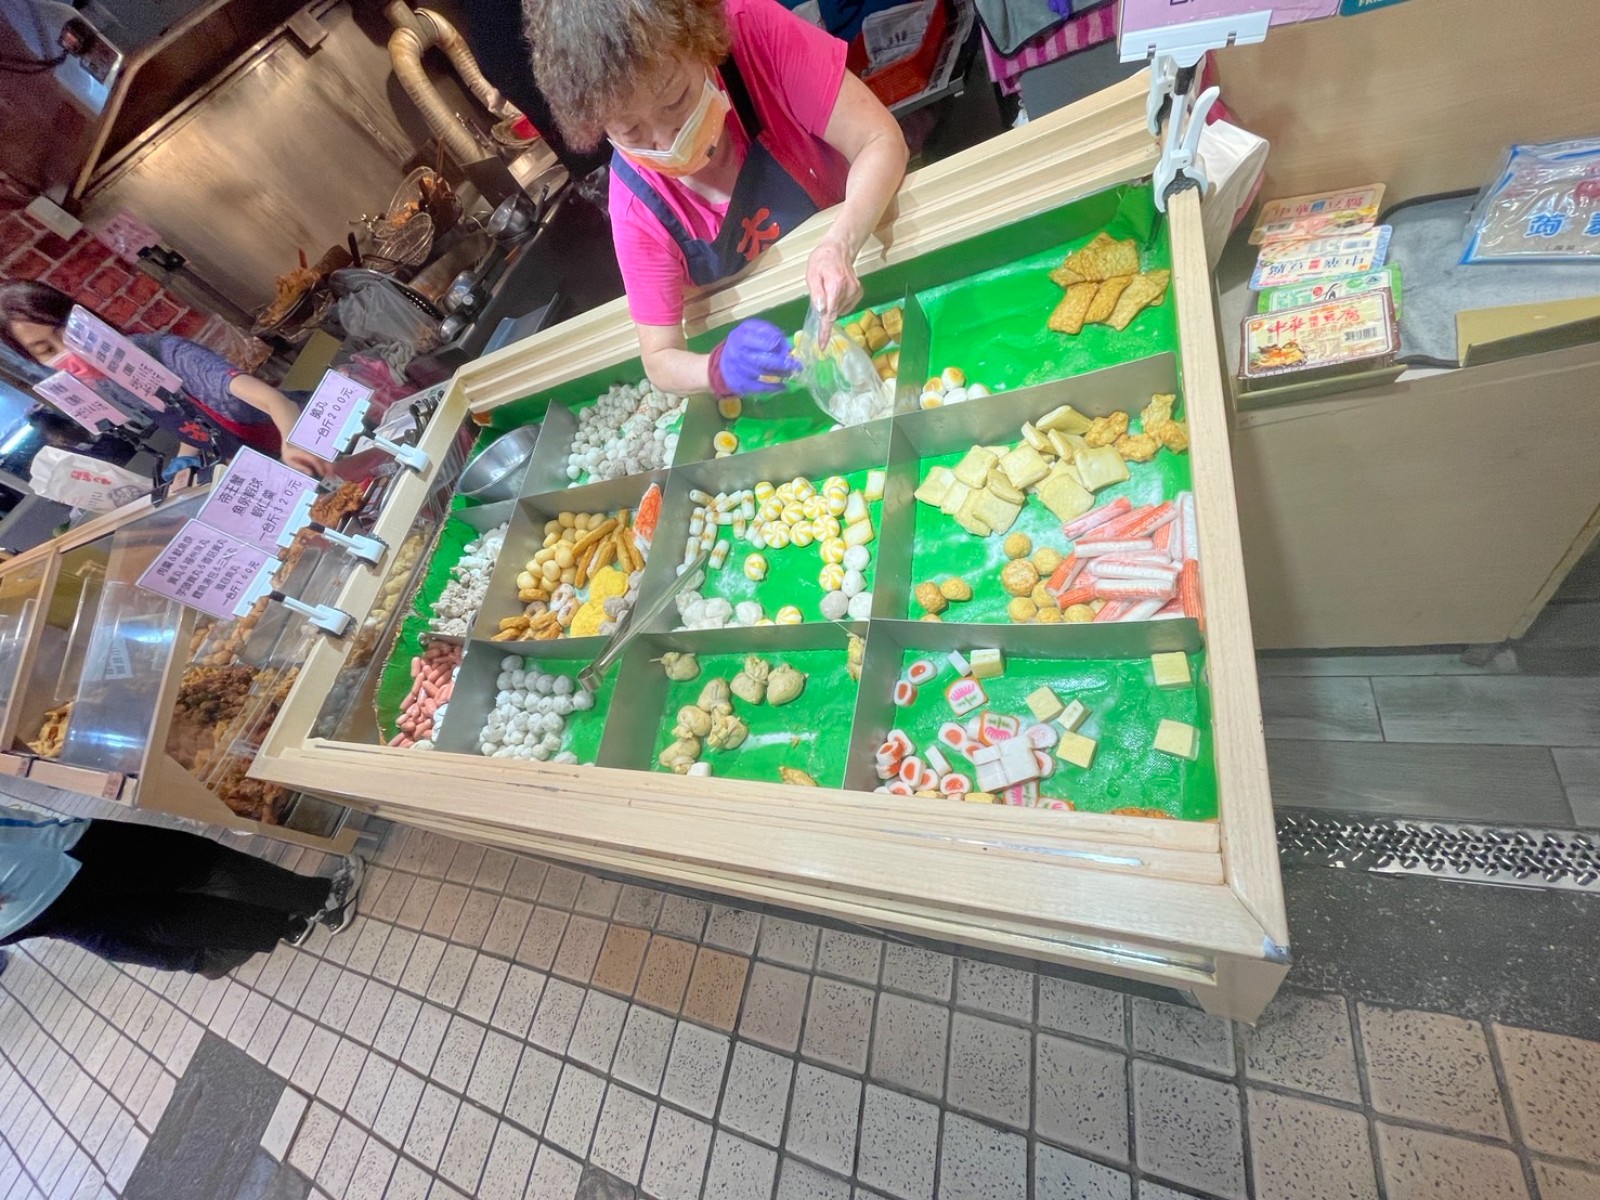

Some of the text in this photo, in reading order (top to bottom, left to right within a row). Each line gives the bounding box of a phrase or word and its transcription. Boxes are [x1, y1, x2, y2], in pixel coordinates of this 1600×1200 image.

[315, 387, 354, 445] 一台斤200元
[218, 473, 246, 504] 帝王蟹
[259, 480, 302, 541] 一台斤320元
